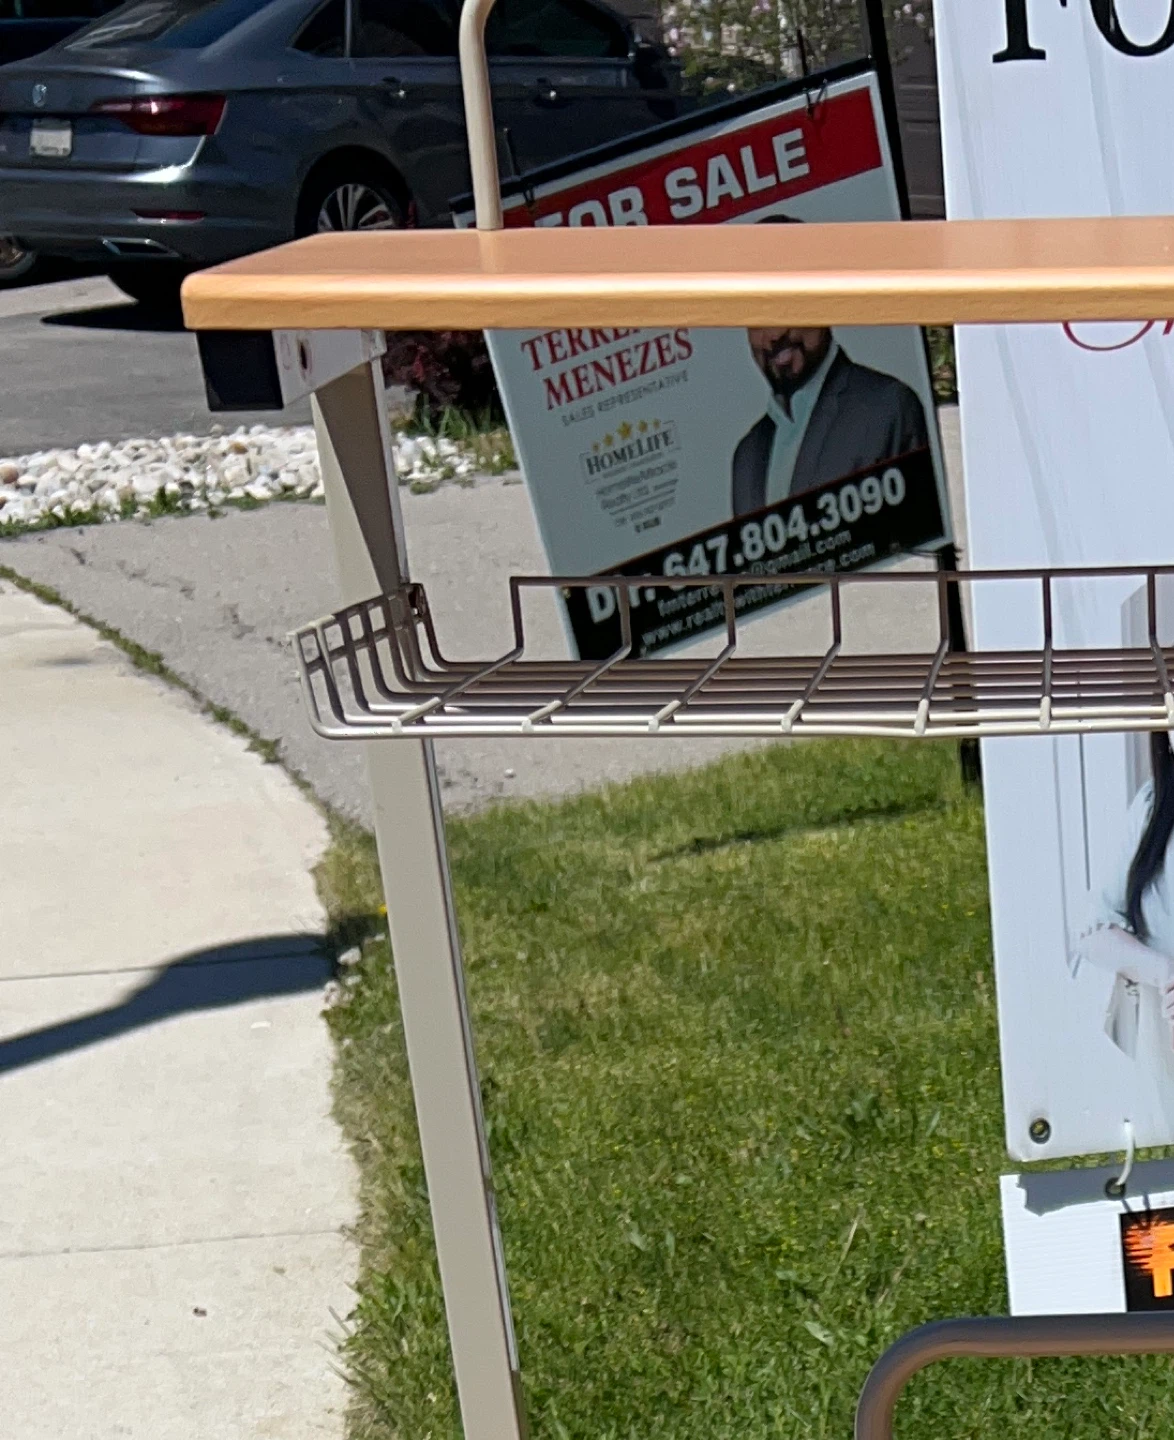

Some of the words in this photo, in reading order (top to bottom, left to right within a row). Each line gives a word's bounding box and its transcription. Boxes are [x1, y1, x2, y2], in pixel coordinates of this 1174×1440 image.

[665, 129, 810, 219] SALE
[543, 328, 694, 410] MENEZES
[663, 468, 906, 591] 647.804.3090
